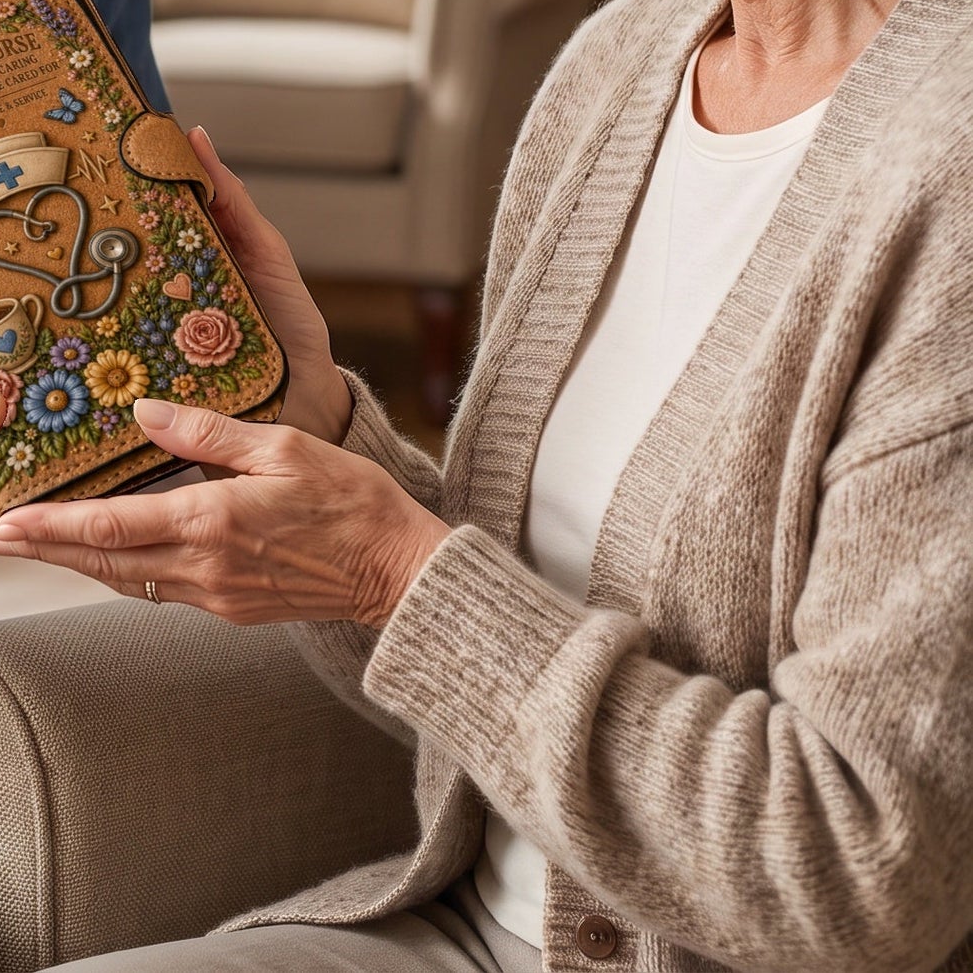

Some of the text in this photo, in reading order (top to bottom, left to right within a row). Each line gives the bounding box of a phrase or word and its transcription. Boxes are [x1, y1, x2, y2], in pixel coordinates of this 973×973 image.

[5, 69, 39, 87] CARED
[39, 61, 60, 75] FOR
[4, 101, 13, 110] &
[13, 88, 48, 107] SERVICE
